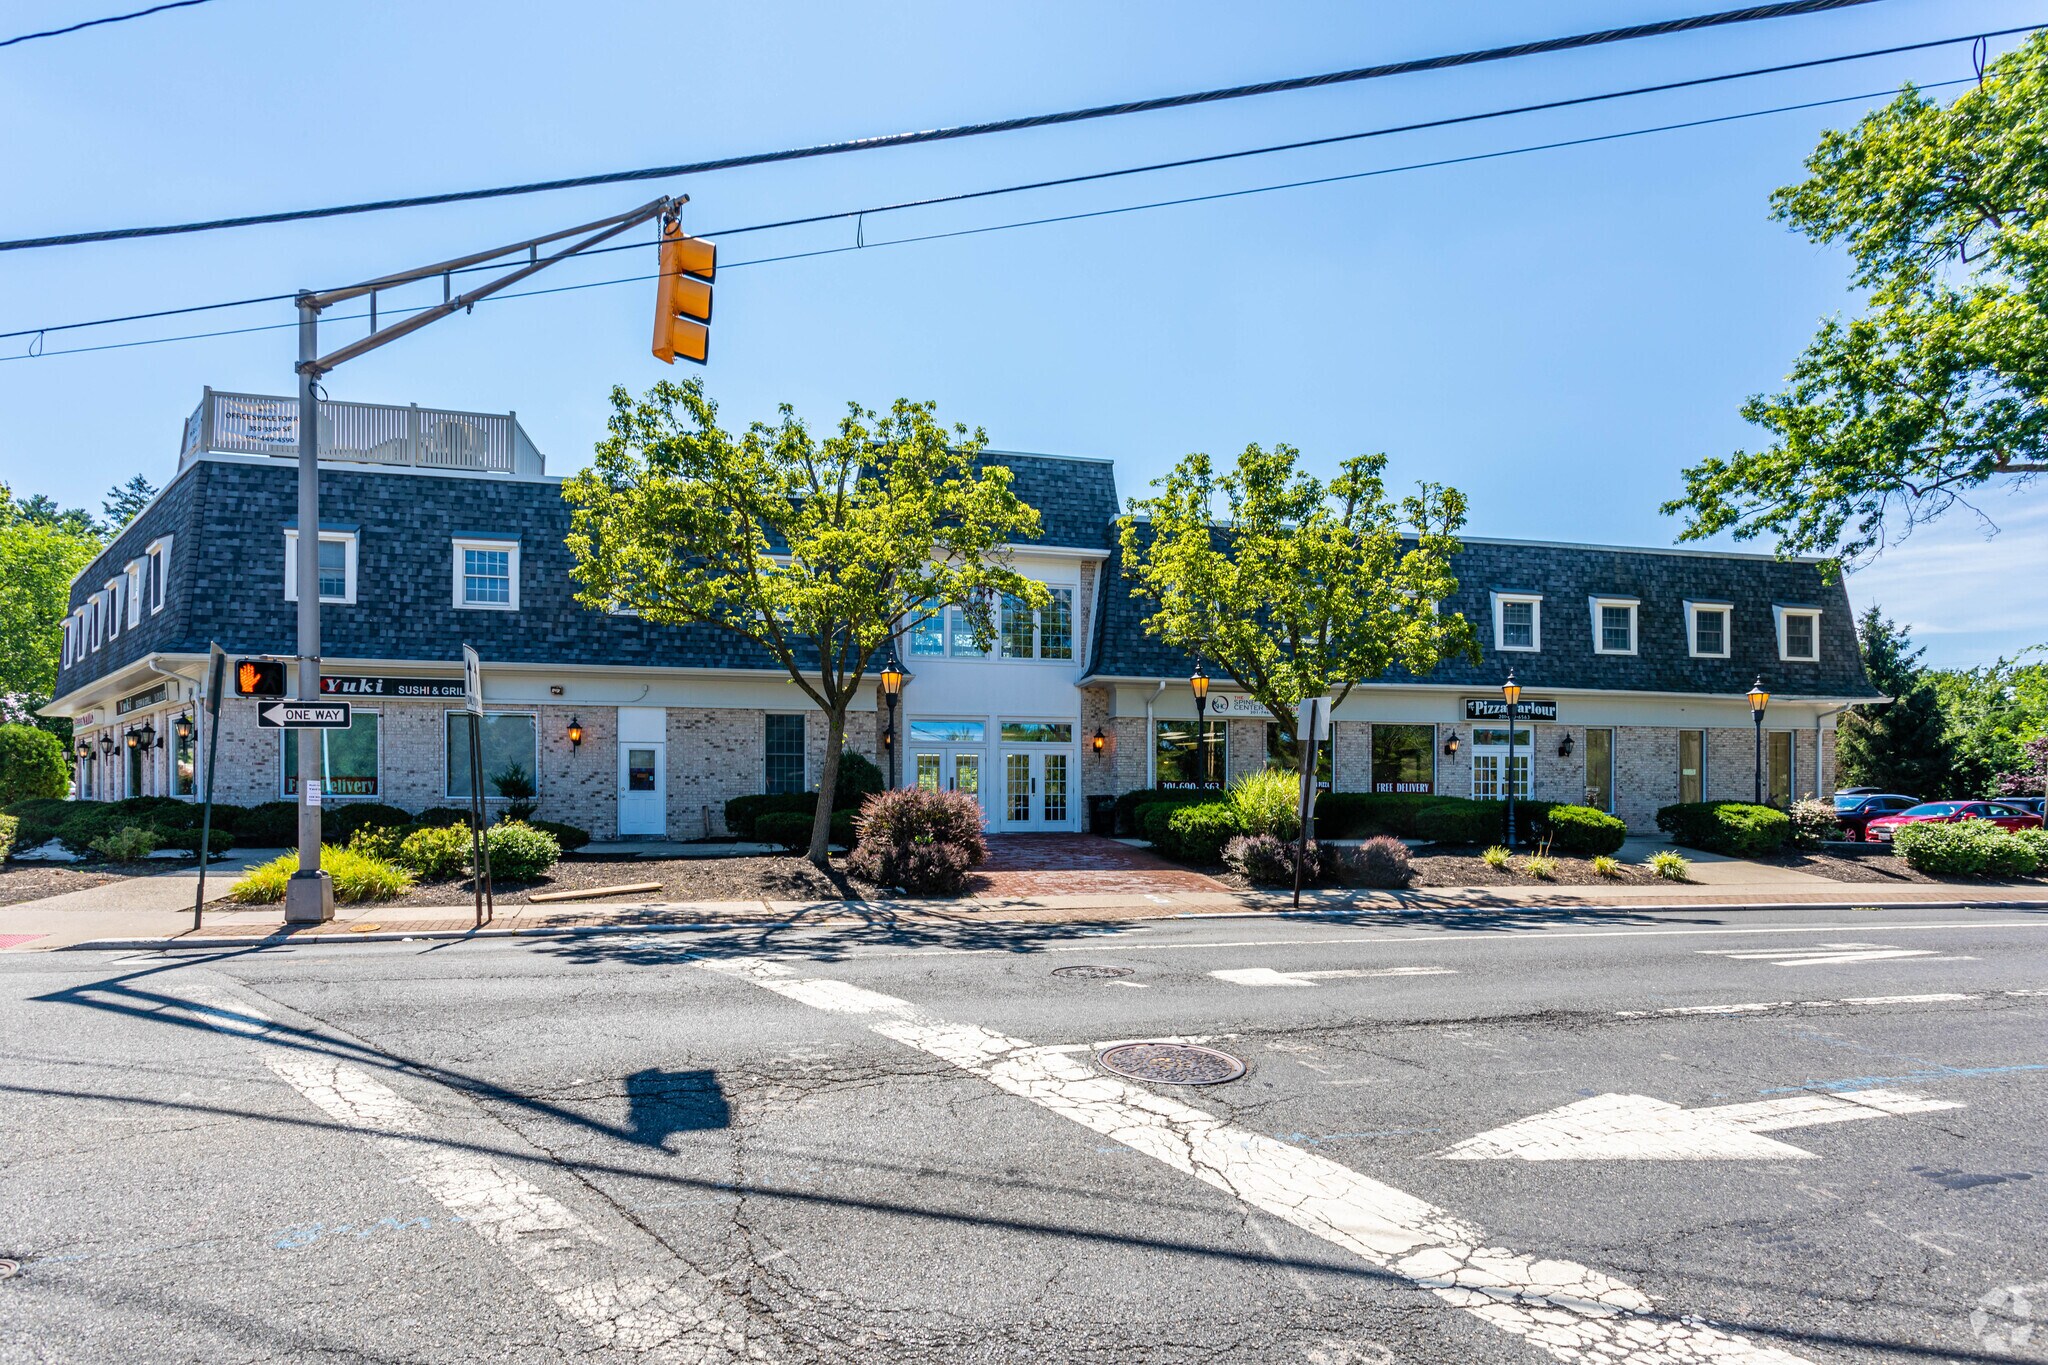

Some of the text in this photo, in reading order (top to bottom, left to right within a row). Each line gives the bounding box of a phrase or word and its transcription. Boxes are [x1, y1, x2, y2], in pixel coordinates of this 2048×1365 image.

[225, 412, 251, 420] OFFICE
[326, 678, 466, 696] Yuki SUSHI & GRIL
[1475, 701, 1507, 716] Pizza
[1517, 702, 1555, 716] arlour
[285, 710, 340, 720] ONE WAY
[1162, 782, 1220, 790] 201-690-563
[1376, 783, 1430, 793] FREE DELIVERY
